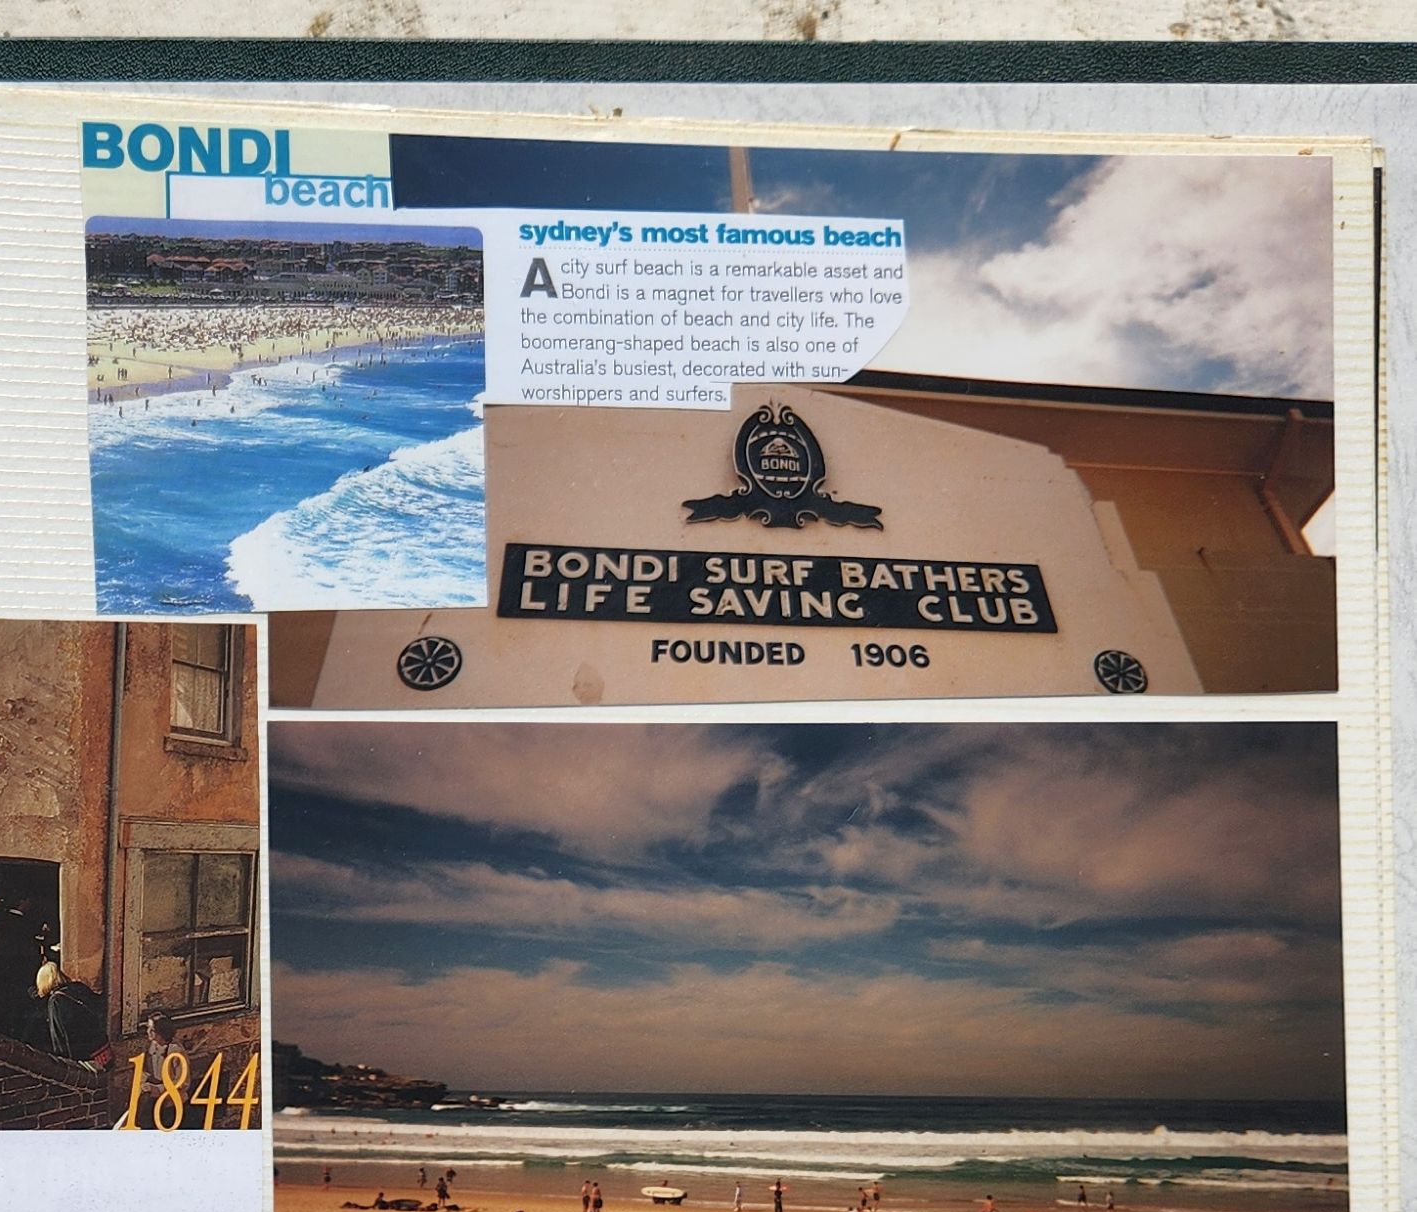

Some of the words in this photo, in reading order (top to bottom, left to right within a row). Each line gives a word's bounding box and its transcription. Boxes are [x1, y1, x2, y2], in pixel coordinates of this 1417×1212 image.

[83, 122, 288, 176] BONDI
[264, 172, 389, 208] beach
[520, 221, 632, 245] sydney's
[642, 224, 708, 243] most
[716, 224, 815, 245] famous
[824, 226, 901, 247] beach
[521, 258, 557, 298] A
[561, 258, 589, 279] city
[596, 259, 628, 275] surf
[634, 259, 683, 275] beach
[690, 260, 702, 276] is
[710, 264, 719, 276] a
[726, 261, 817, 278] remarkable
[824, 264, 868, 279] asset
[874, 264, 903, 279] and
[562, 283, 609, 299] Bondi
[617, 284, 629, 300] is
[636, 289, 646, 300] a
[652, 286, 715, 305] magnet
[721, 285, 744, 301] for
[750, 286, 823, 303] travellers
[830, 288, 863, 304] who
[870, 288, 902, 304] love
[761, 459, 800, 473] BONDI
[525, 551, 676, 581] BONDI
[706, 558, 812, 585] SURF
[841, 563, 1028, 592] BATHERS
[521, 583, 650, 612] LIFE
[691, 589, 863, 617] SAVING
[919, 596, 1037, 623] CLUB
[652, 640, 805, 665] FOUNDED
[851, 643, 930, 668] 1906
[120, 1052, 259, 1132] 1844
